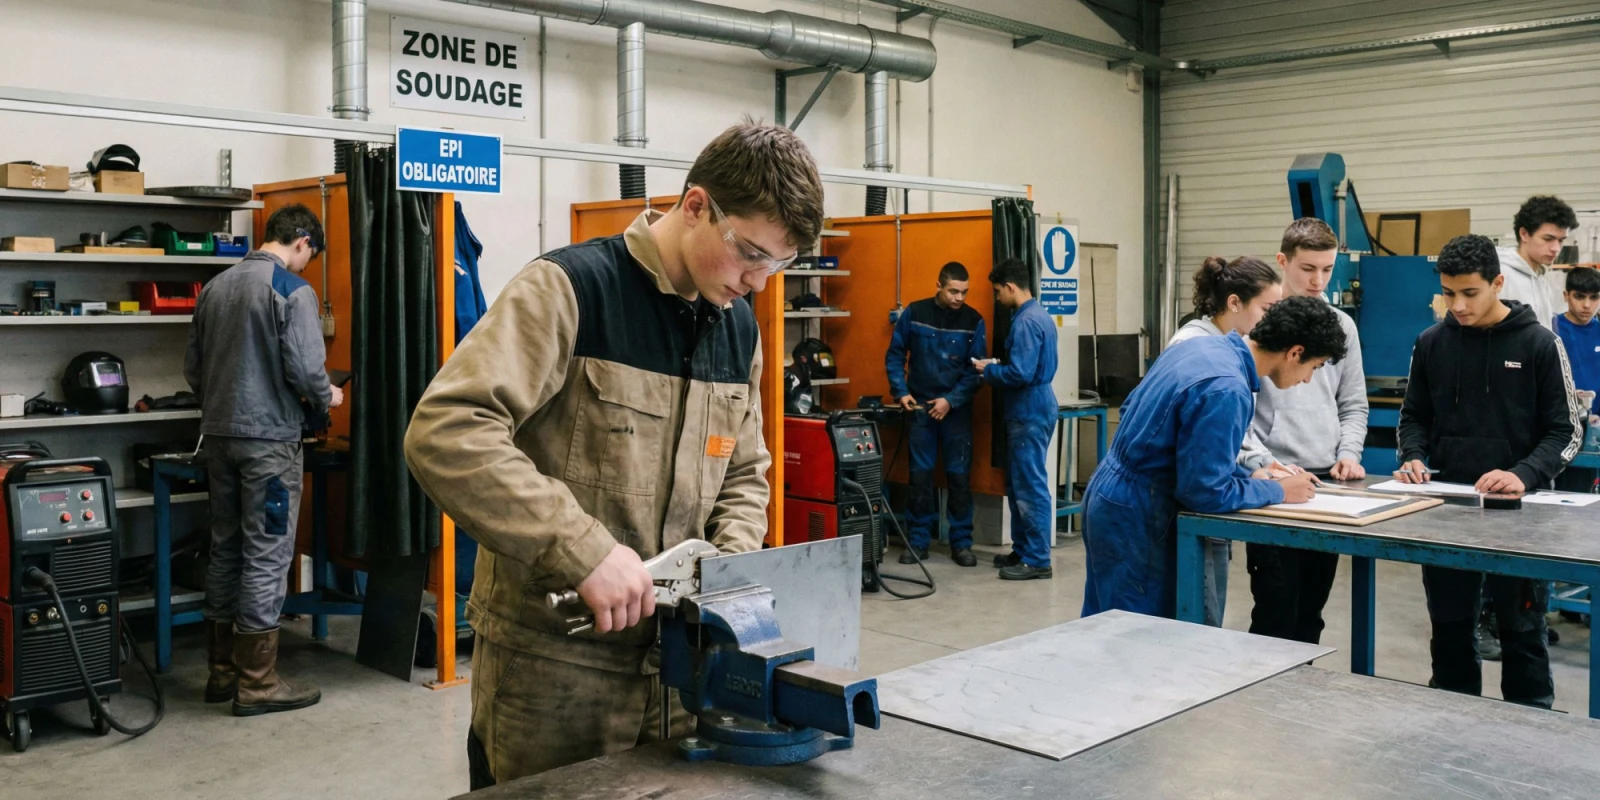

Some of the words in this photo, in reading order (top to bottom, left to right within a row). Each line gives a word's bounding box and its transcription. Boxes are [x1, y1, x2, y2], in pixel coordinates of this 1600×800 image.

[402, 29, 476, 64] ZONE
[485, 41, 517, 69] DE
[396, 68, 523, 108] SOUDAGE
[439, 138, 462, 159] EPI
[402, 161, 497, 186] OBLIGATOIRE
